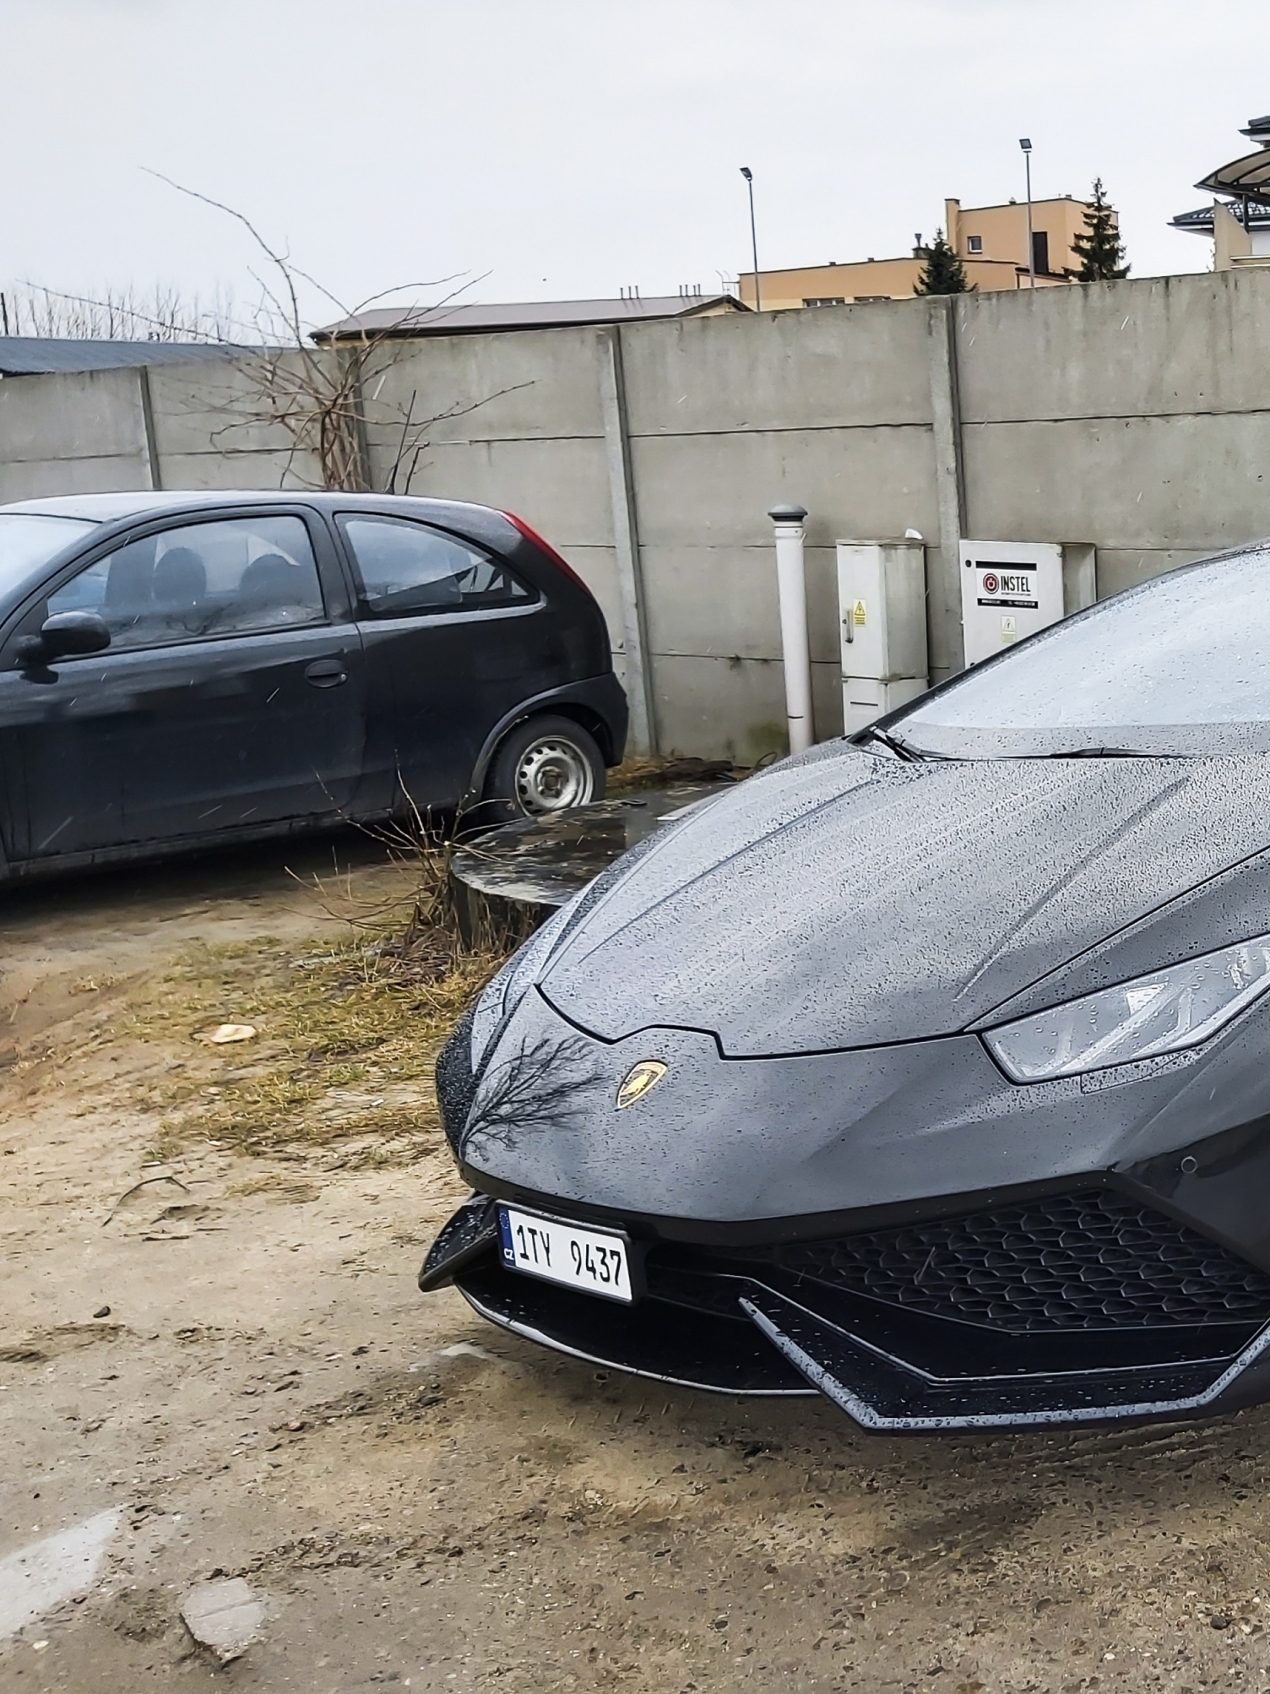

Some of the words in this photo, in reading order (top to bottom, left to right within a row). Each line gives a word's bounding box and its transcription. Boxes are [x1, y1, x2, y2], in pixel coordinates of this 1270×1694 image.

[1001, 576, 1031, 592] INSTEL
[516, 1224, 551, 1267] 1TY
[570, 1240, 621, 1286] 9437
